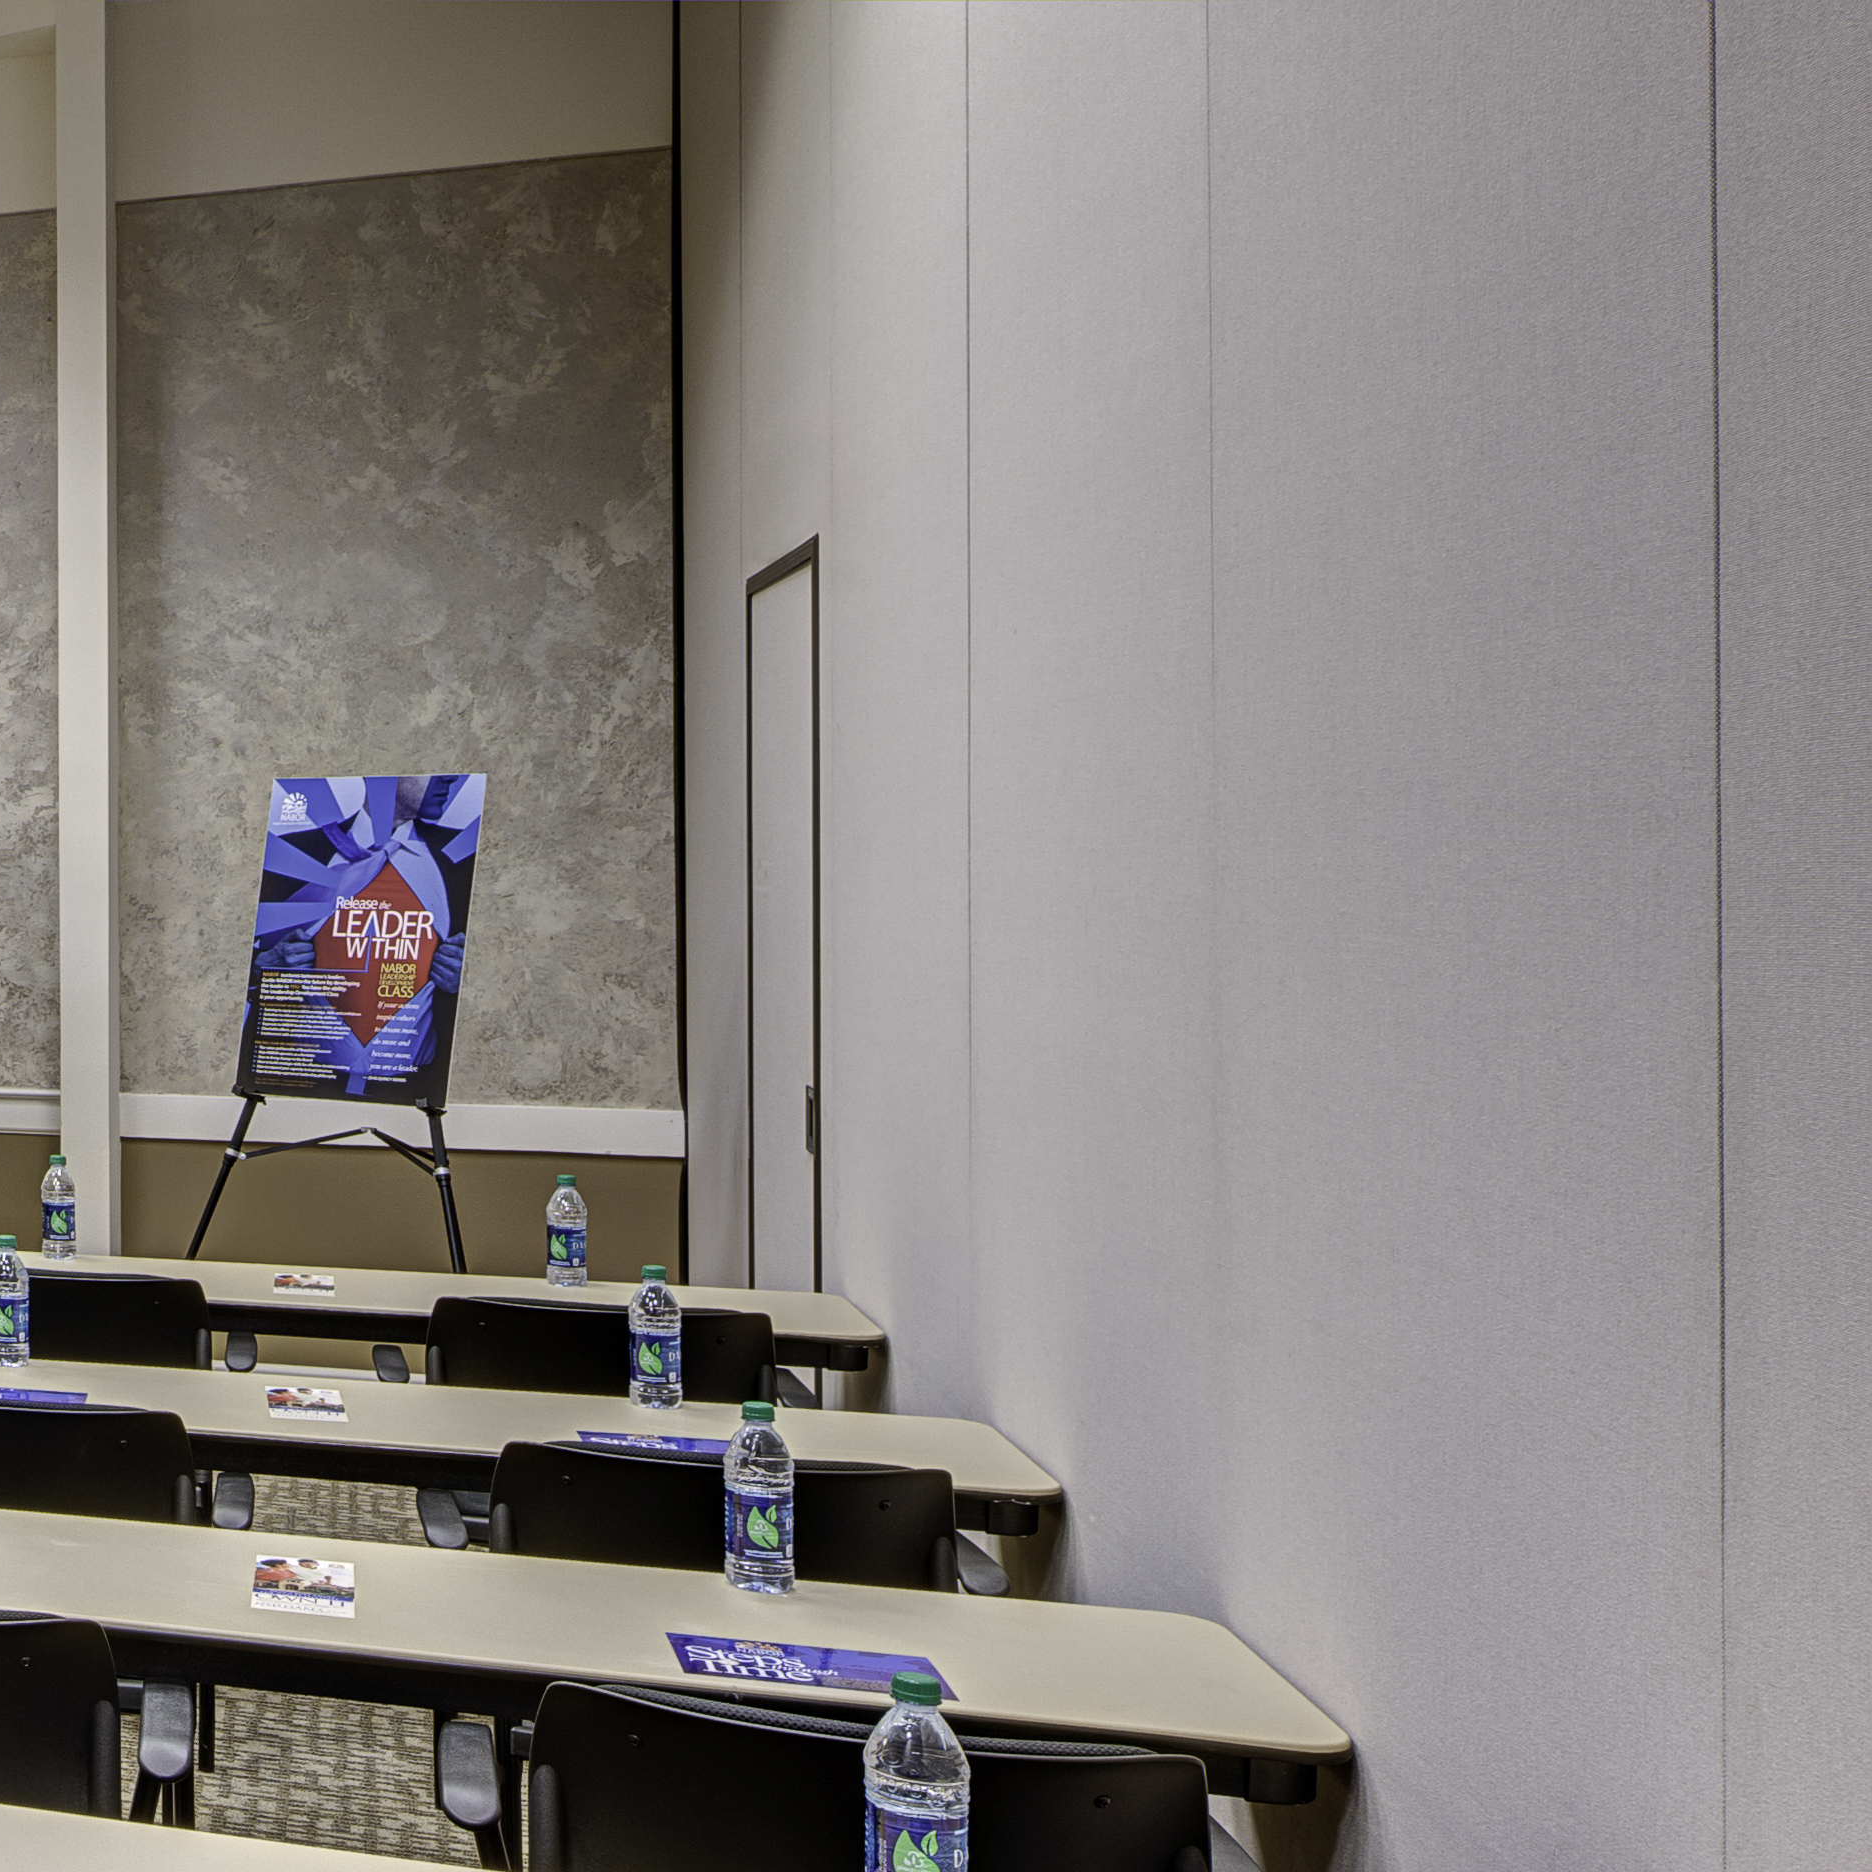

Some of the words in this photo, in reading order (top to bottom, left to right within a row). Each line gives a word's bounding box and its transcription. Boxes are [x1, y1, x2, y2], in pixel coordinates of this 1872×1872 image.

[335, 895, 379, 910] Release
[378, 901, 393, 910] the
[332, 910, 435, 940] LEADER
[380, 963, 417, 974] NABOR
[377, 985, 415, 998] CLASS
[685, 1645, 806, 1669] Steps
